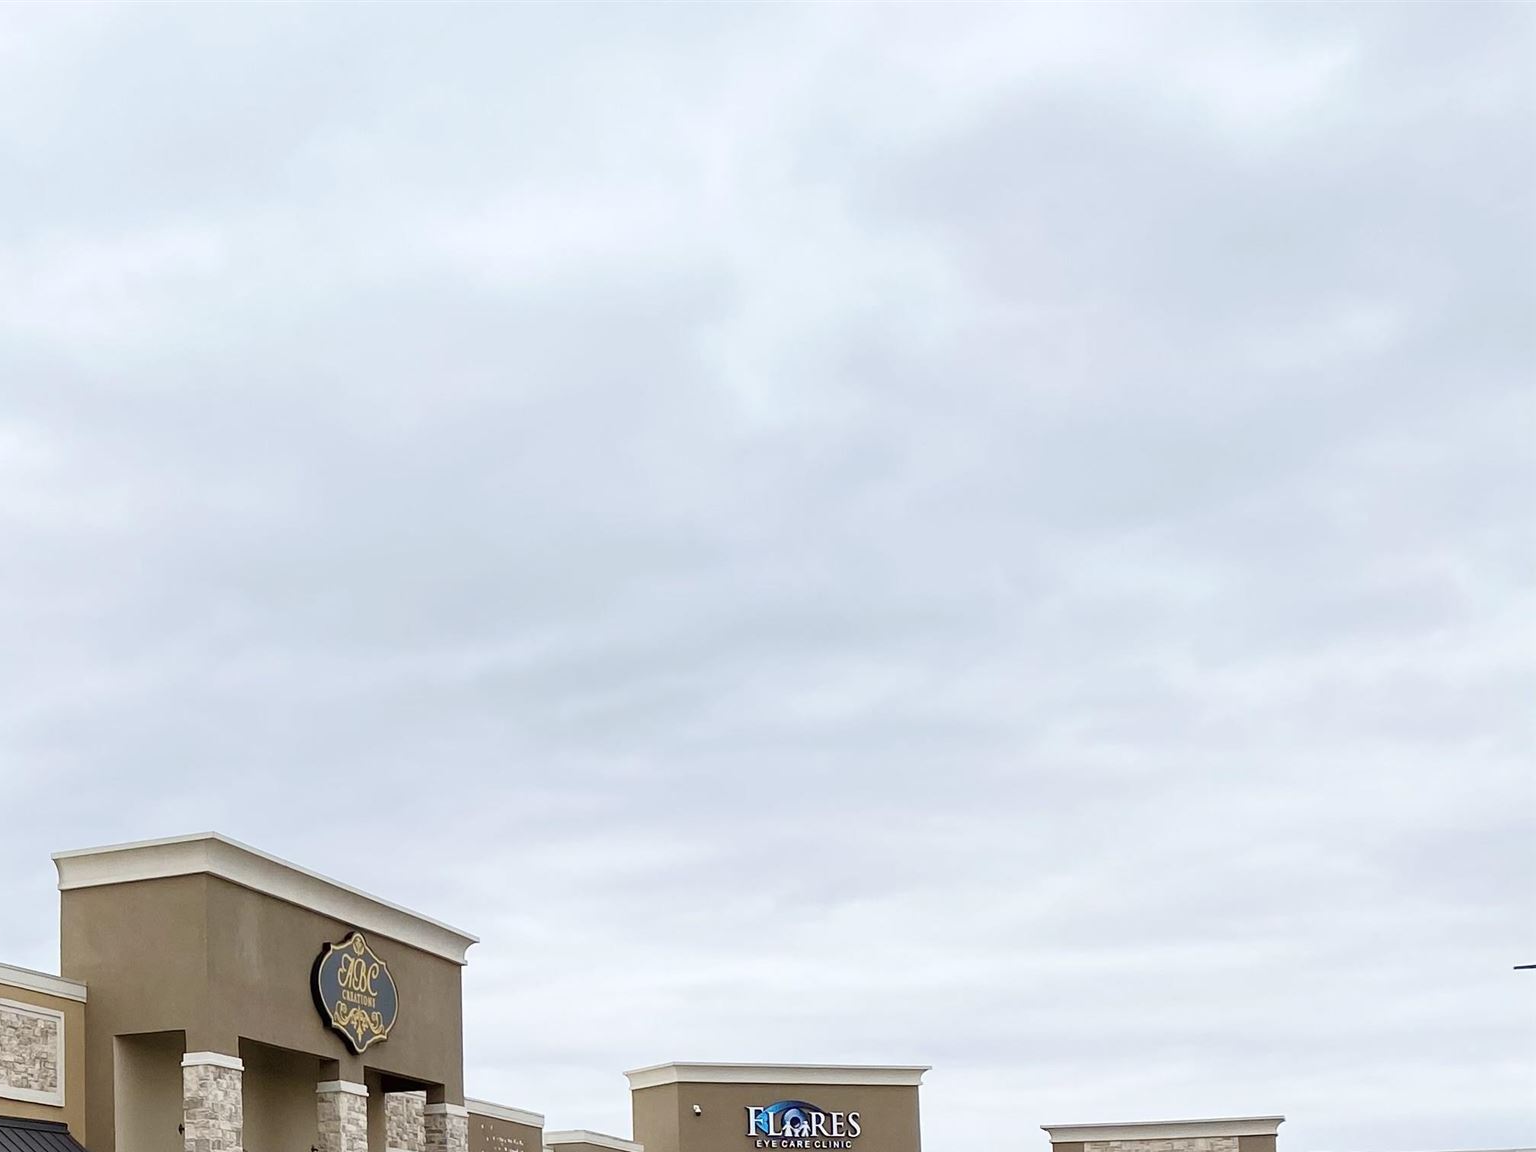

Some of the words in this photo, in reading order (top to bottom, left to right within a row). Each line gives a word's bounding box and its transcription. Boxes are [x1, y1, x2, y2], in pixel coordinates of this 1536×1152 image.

[338, 953, 379, 996] ABC
[341, 990, 376, 1009] CREATIONS
[745, 1106, 861, 1138] FLORES
[756, 1140, 777, 1148] EYE
[781, 1140, 811, 1148] CARE
[814, 1140, 852, 1148] CLINIC
